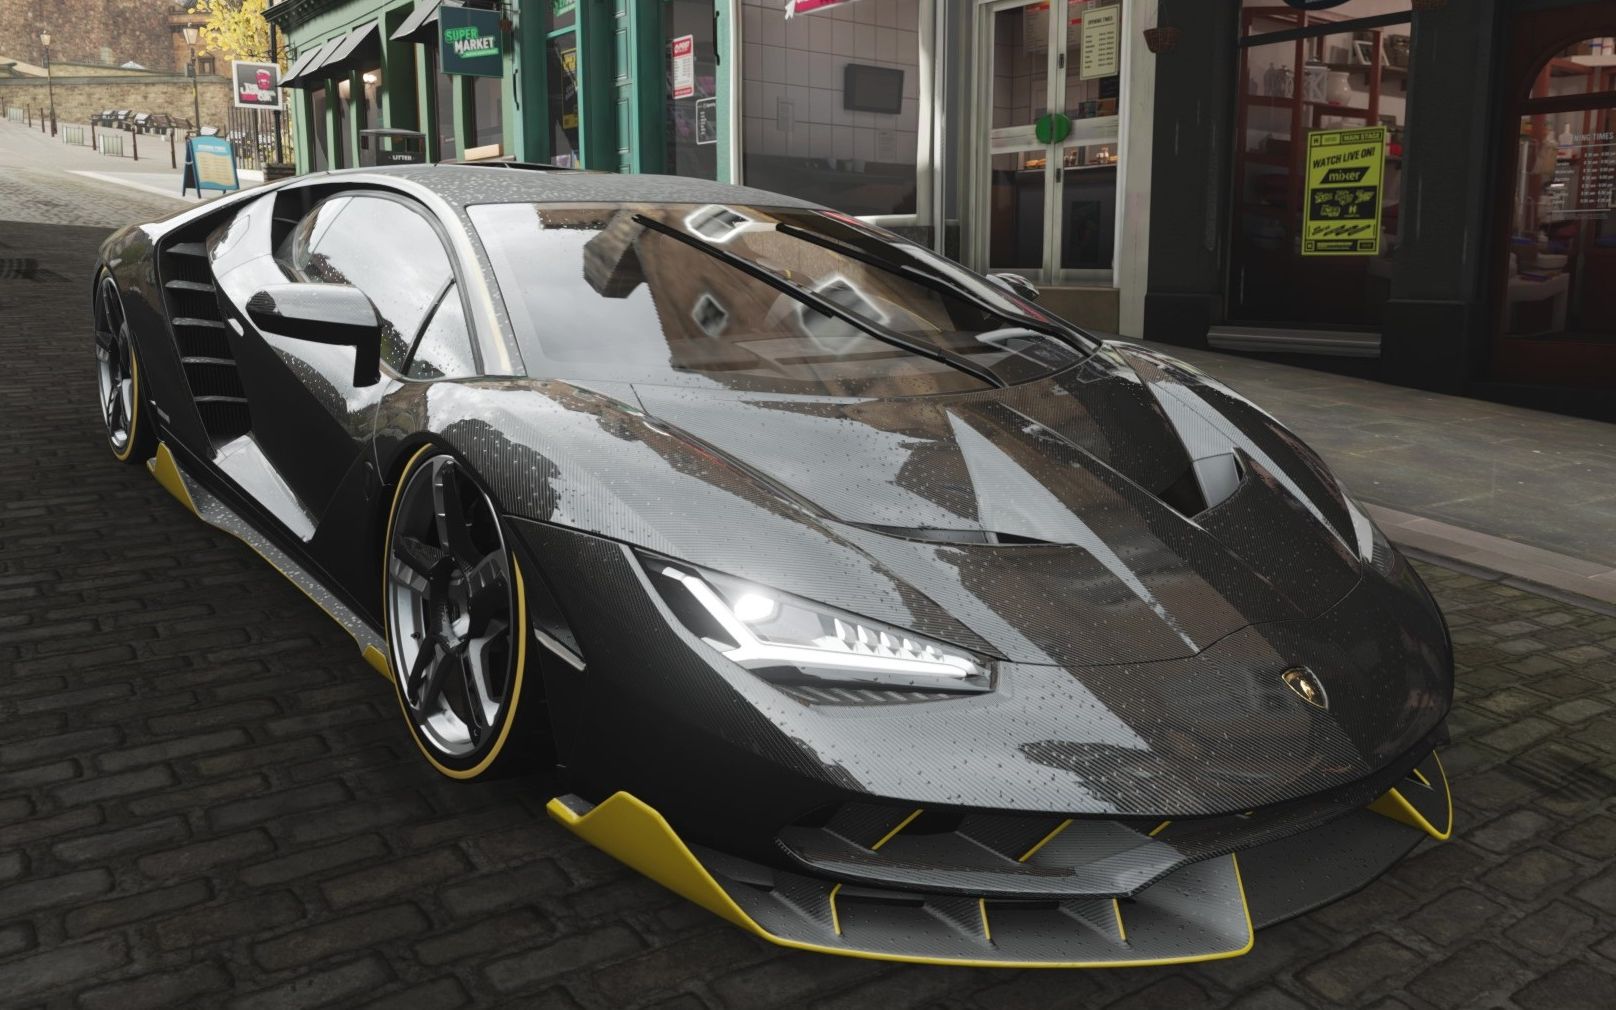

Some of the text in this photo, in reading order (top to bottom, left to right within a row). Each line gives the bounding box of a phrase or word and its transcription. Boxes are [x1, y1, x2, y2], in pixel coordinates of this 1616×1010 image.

[445, 27, 478, 42] SUPER
[454, 36, 494, 55] MARKET
[1593, 132, 1614, 140] TIMES
[1313, 154, 1341, 169] WATCH
[1343, 150, 1360, 162] LIVE
[1328, 169, 1361, 181] mixer
